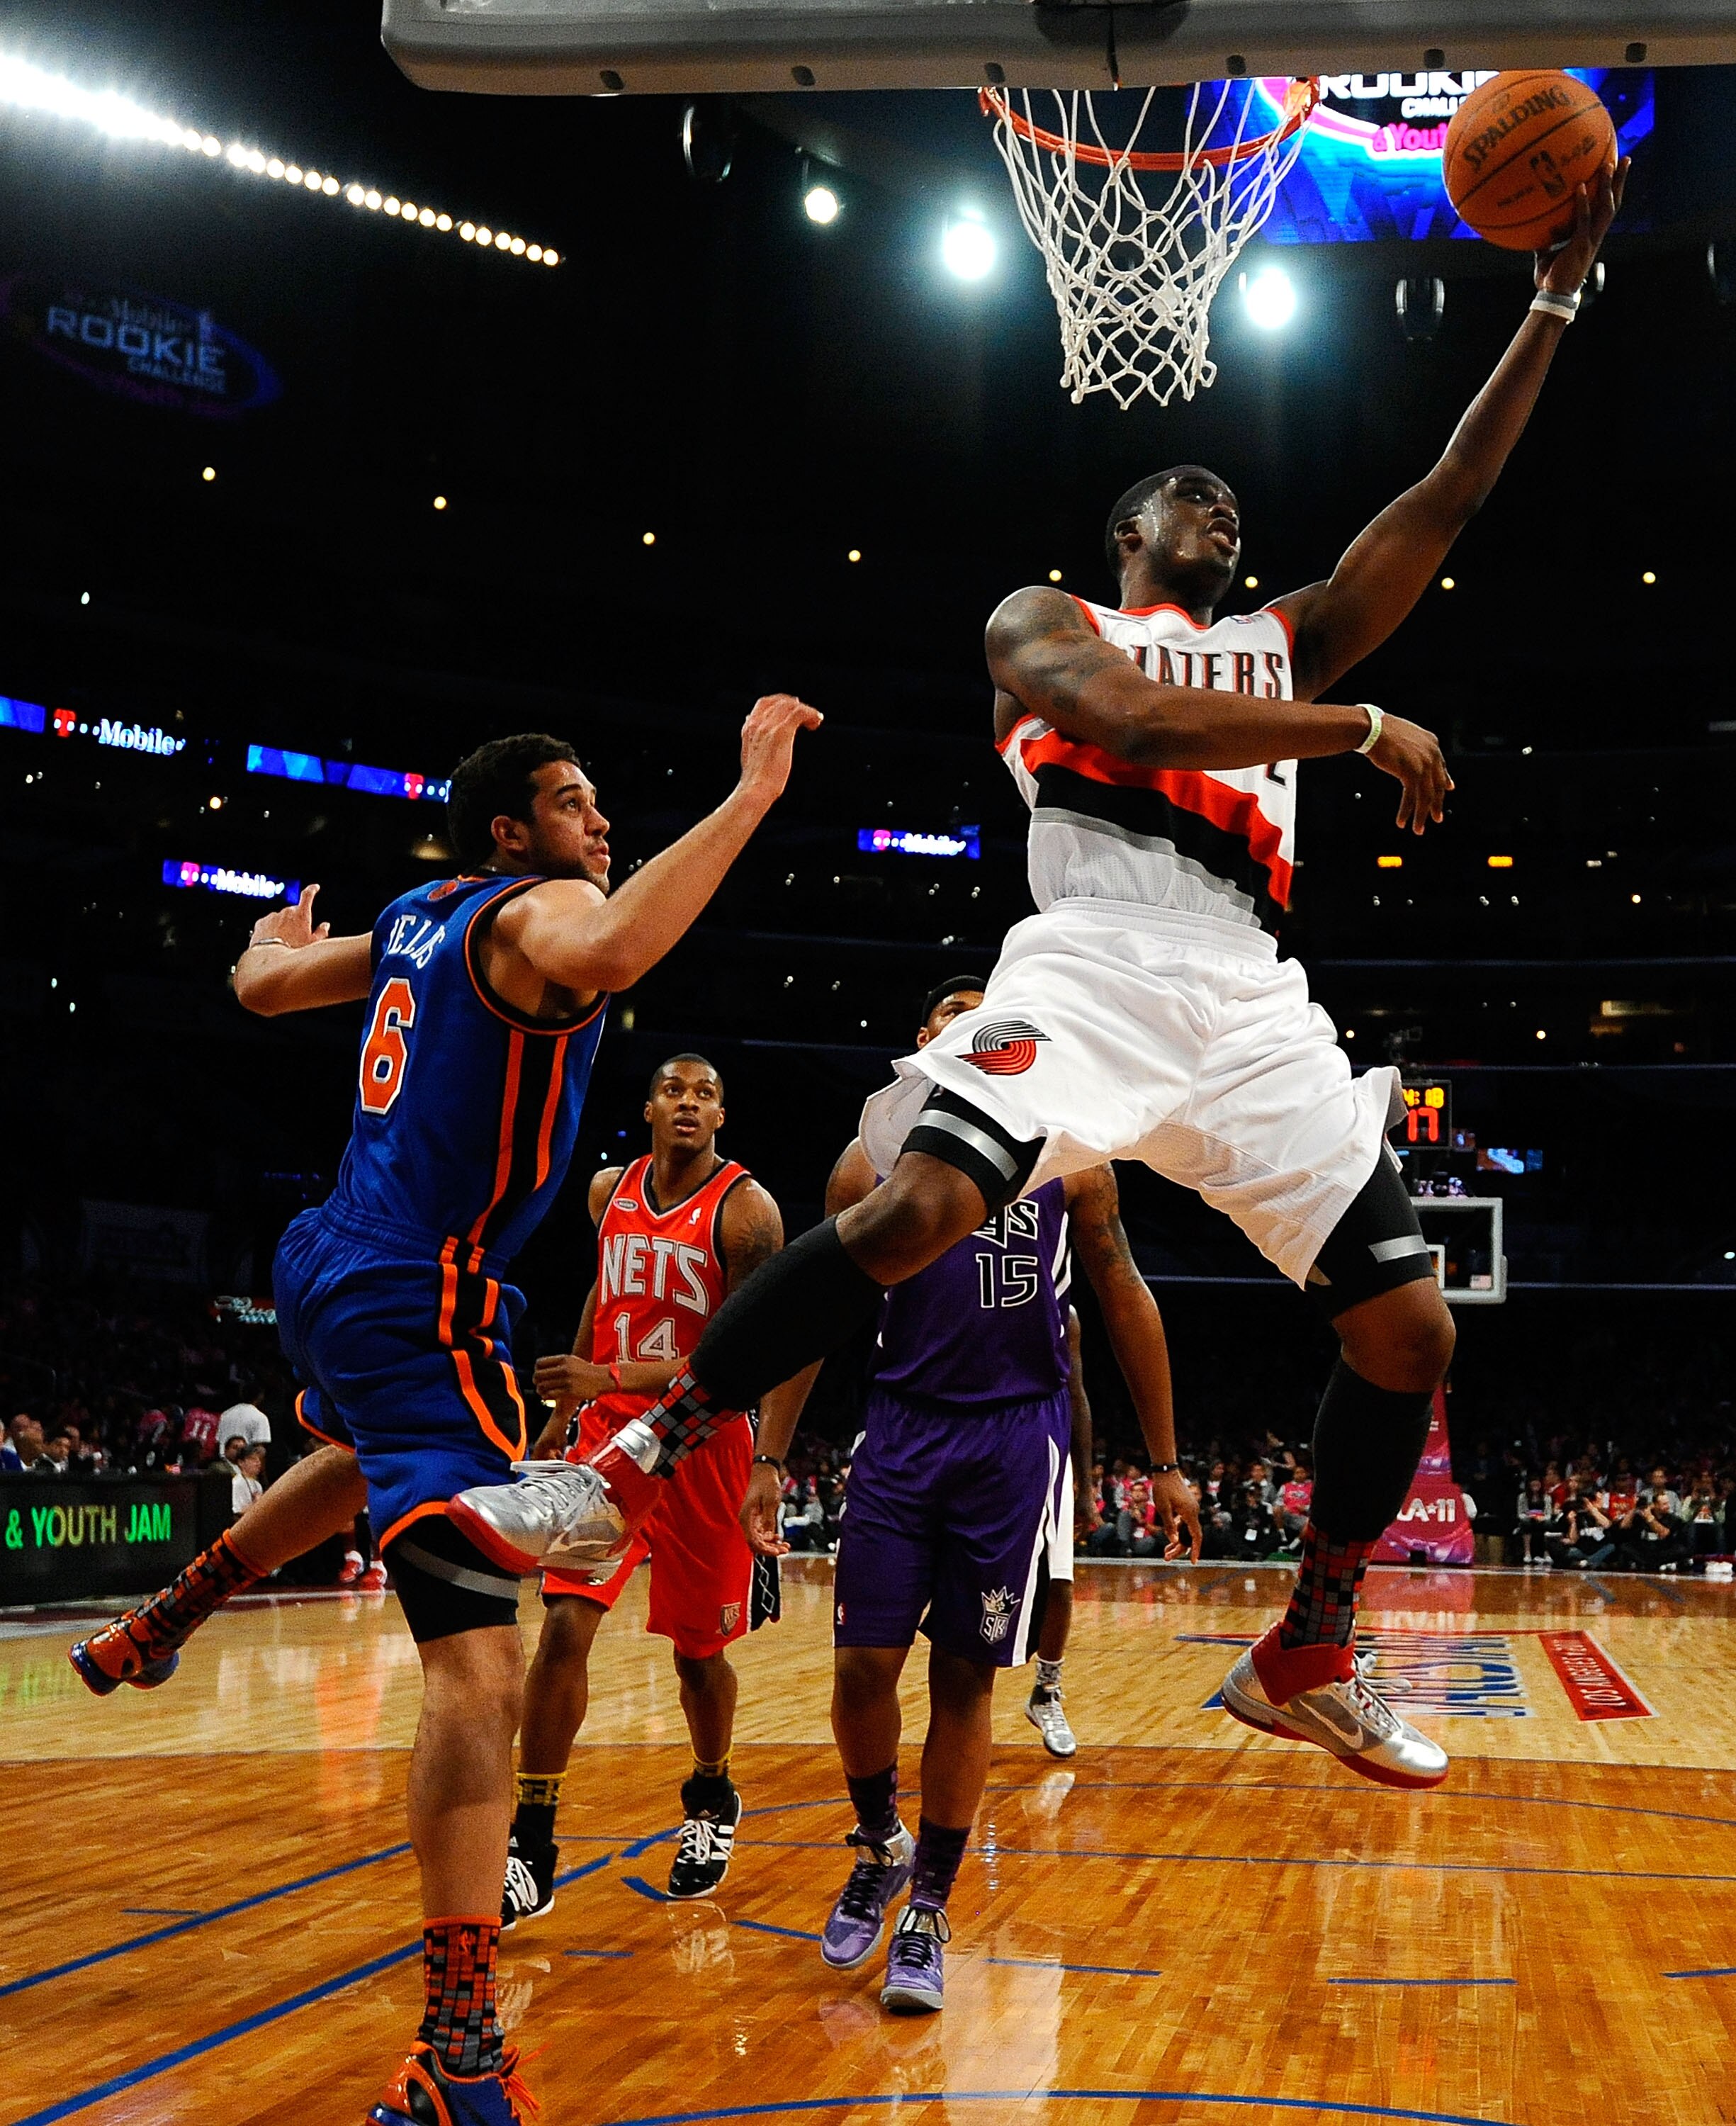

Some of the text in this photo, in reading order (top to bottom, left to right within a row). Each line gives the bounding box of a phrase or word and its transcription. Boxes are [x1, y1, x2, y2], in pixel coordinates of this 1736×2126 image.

[1462, 84, 1574, 174] SPALDING
[47, 306, 226, 373] ROOKIE
[359, 977, 416, 1115] 6
[1408, 1108, 1438, 1142] 17
[601, 1234, 708, 1317] NETS
[976, 1253, 1037, 1308] 15
[614, 1312, 680, 1362] 14
[5, 1503, 171, 1550] & YOUTH JAM
